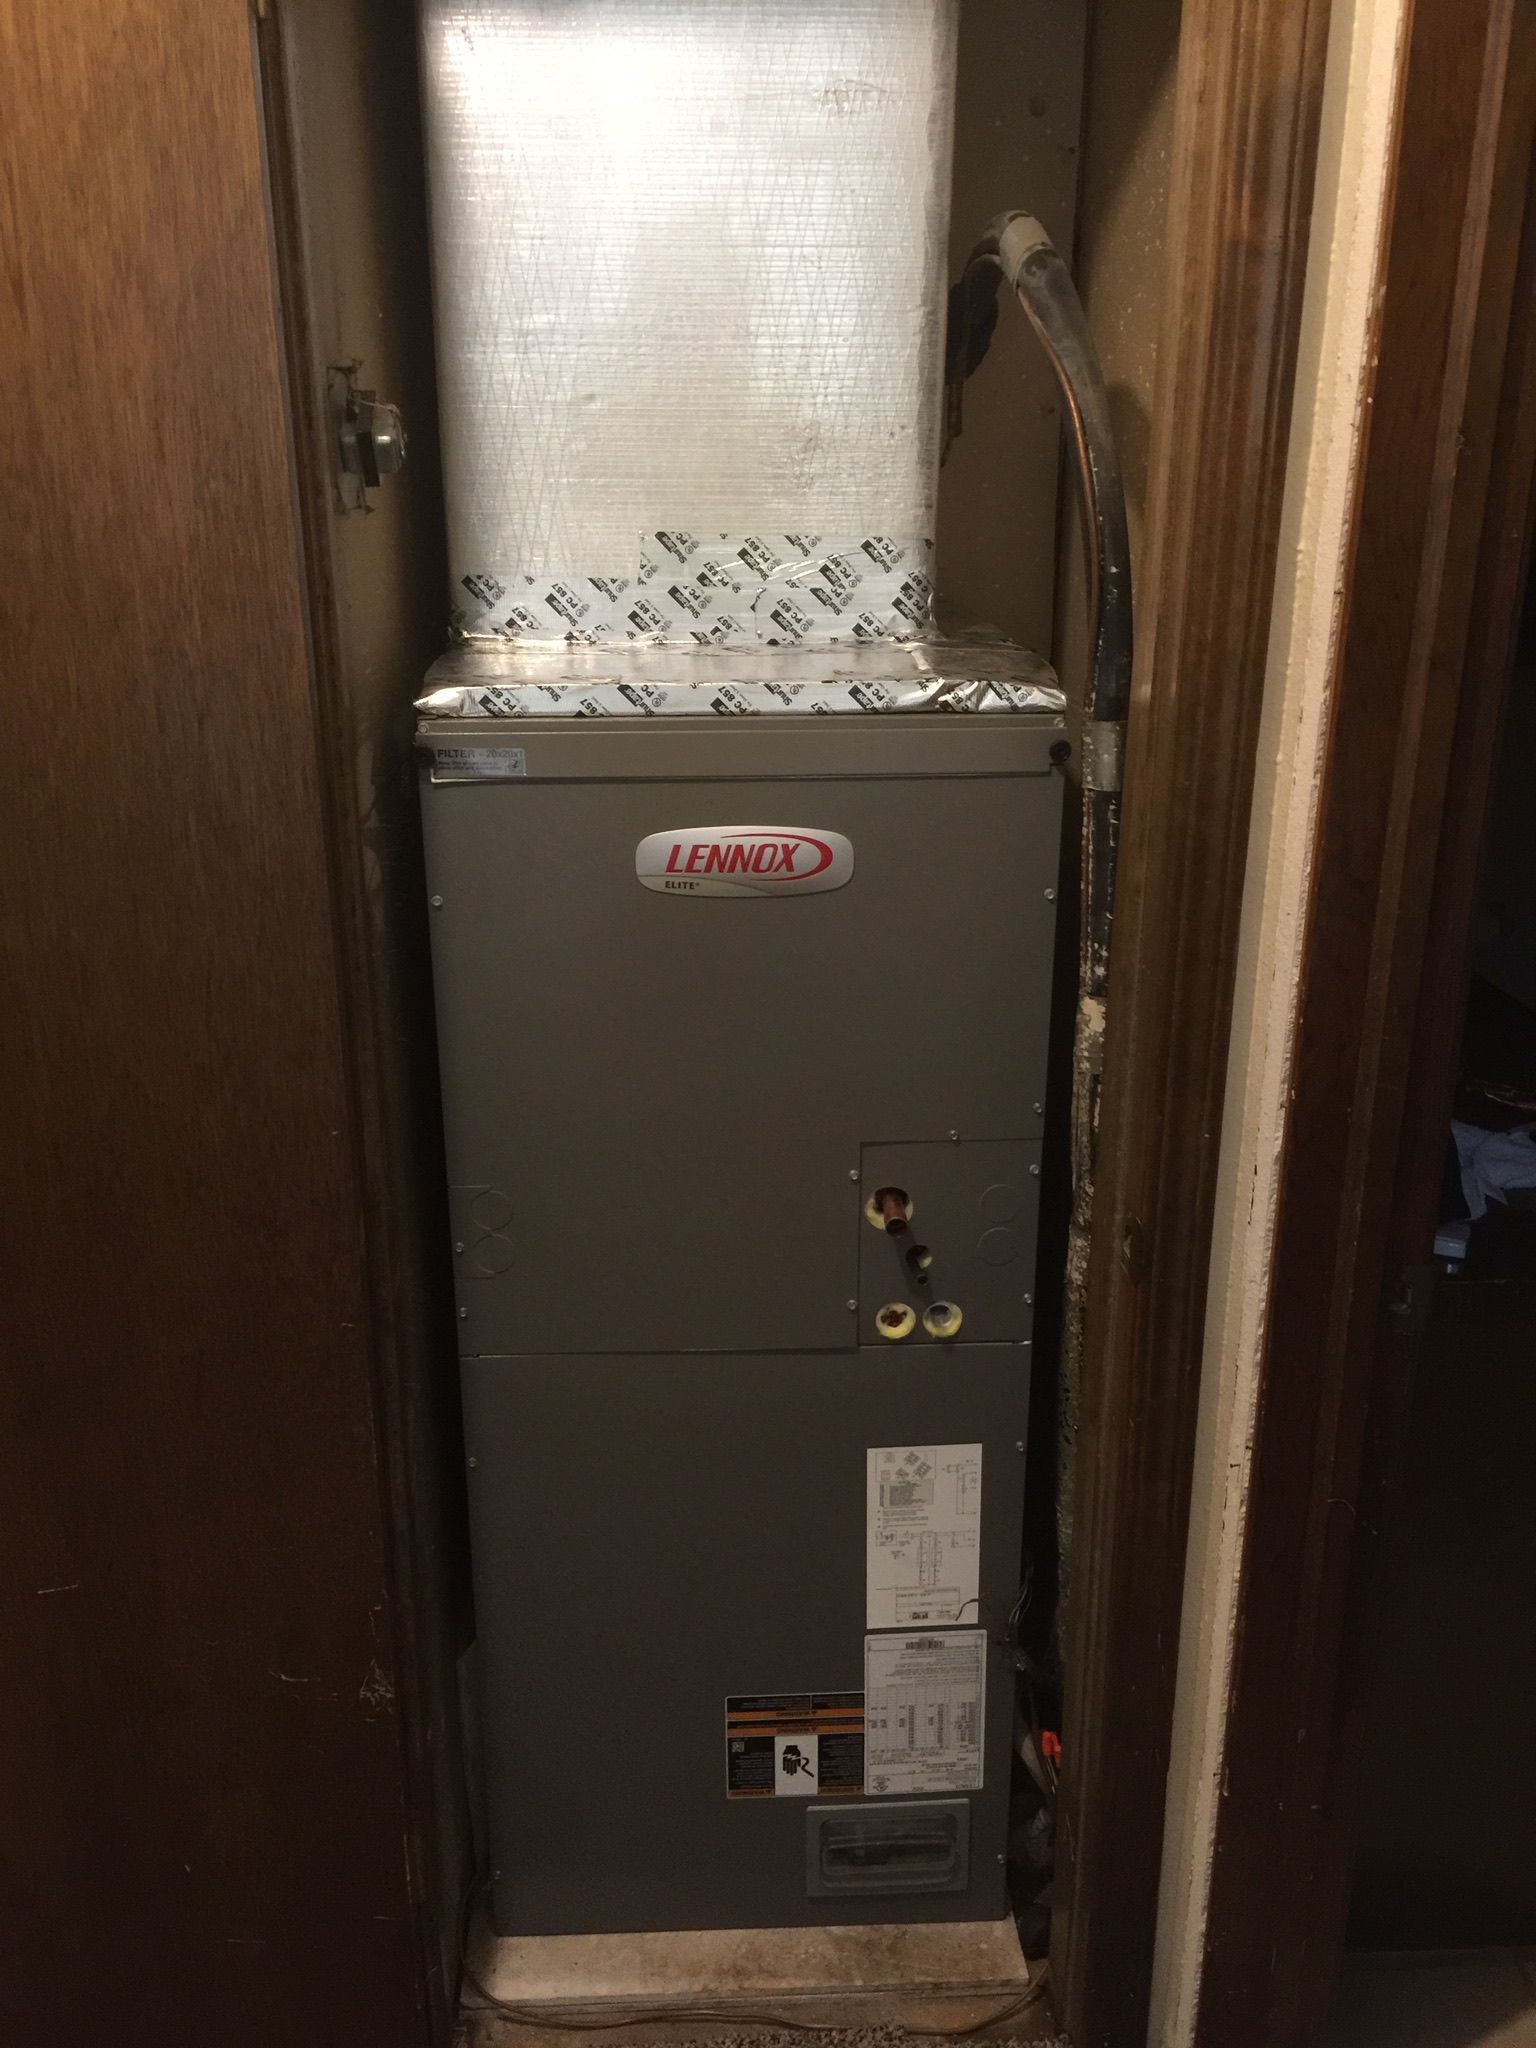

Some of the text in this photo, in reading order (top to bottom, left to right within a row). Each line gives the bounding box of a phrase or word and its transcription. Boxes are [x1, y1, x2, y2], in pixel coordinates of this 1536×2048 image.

[675, 532, 688, 546] PC
[744, 536, 771, 563] PC 857
[881, 542, 894, 555] PC
[839, 566, 852, 579] PC
[551, 581, 568, 598] 857
[688, 588, 701, 601] PC
[566, 596, 579, 609] PC
[634, 598, 650, 615] 857
[776, 597, 792, 613] 857
[511, 606, 528, 623] 857
[648, 612, 661, 626] PC
[717, 614, 733, 630] 857
[790, 611, 803, 624] PC
[858, 611, 874, 627] 857
[872, 625, 885, 637] PC
[640, 683, 655, 698] PC
[717, 684, 736, 702] 857
[870, 688, 886, 702] PC
[502, 697, 517, 711] PC
[579, 697, 599, 715] 857
[733, 699, 749, 714] PC
[437, 749, 475, 759] FILTER
[665, 843, 800, 874] LENNOX
